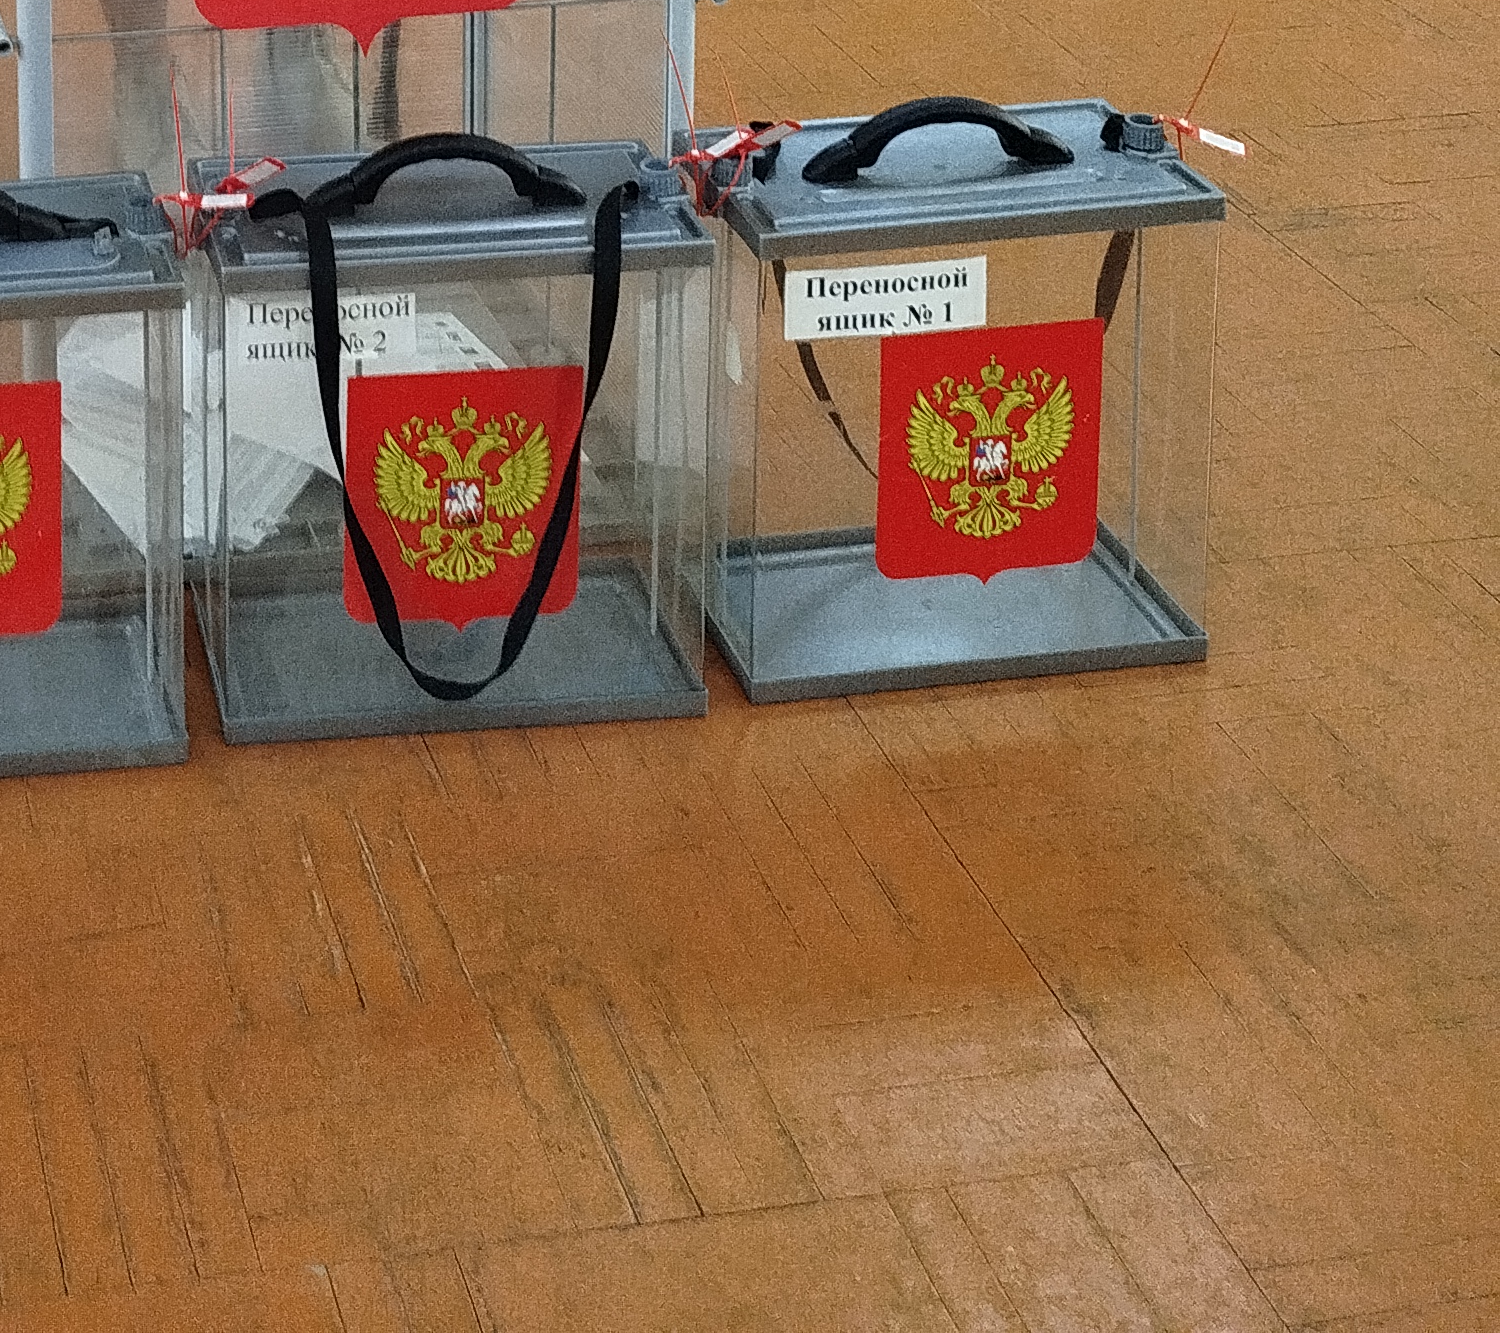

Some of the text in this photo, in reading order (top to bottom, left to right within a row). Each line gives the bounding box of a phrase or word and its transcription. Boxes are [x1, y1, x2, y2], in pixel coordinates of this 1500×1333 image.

[805, 266, 968, 302] Переносной
[248, 294, 410, 330] Пересной
[817, 301, 953, 332] ящик № 1
[246, 341, 317, 363] ящик
[373, 330, 387, 353] 2
